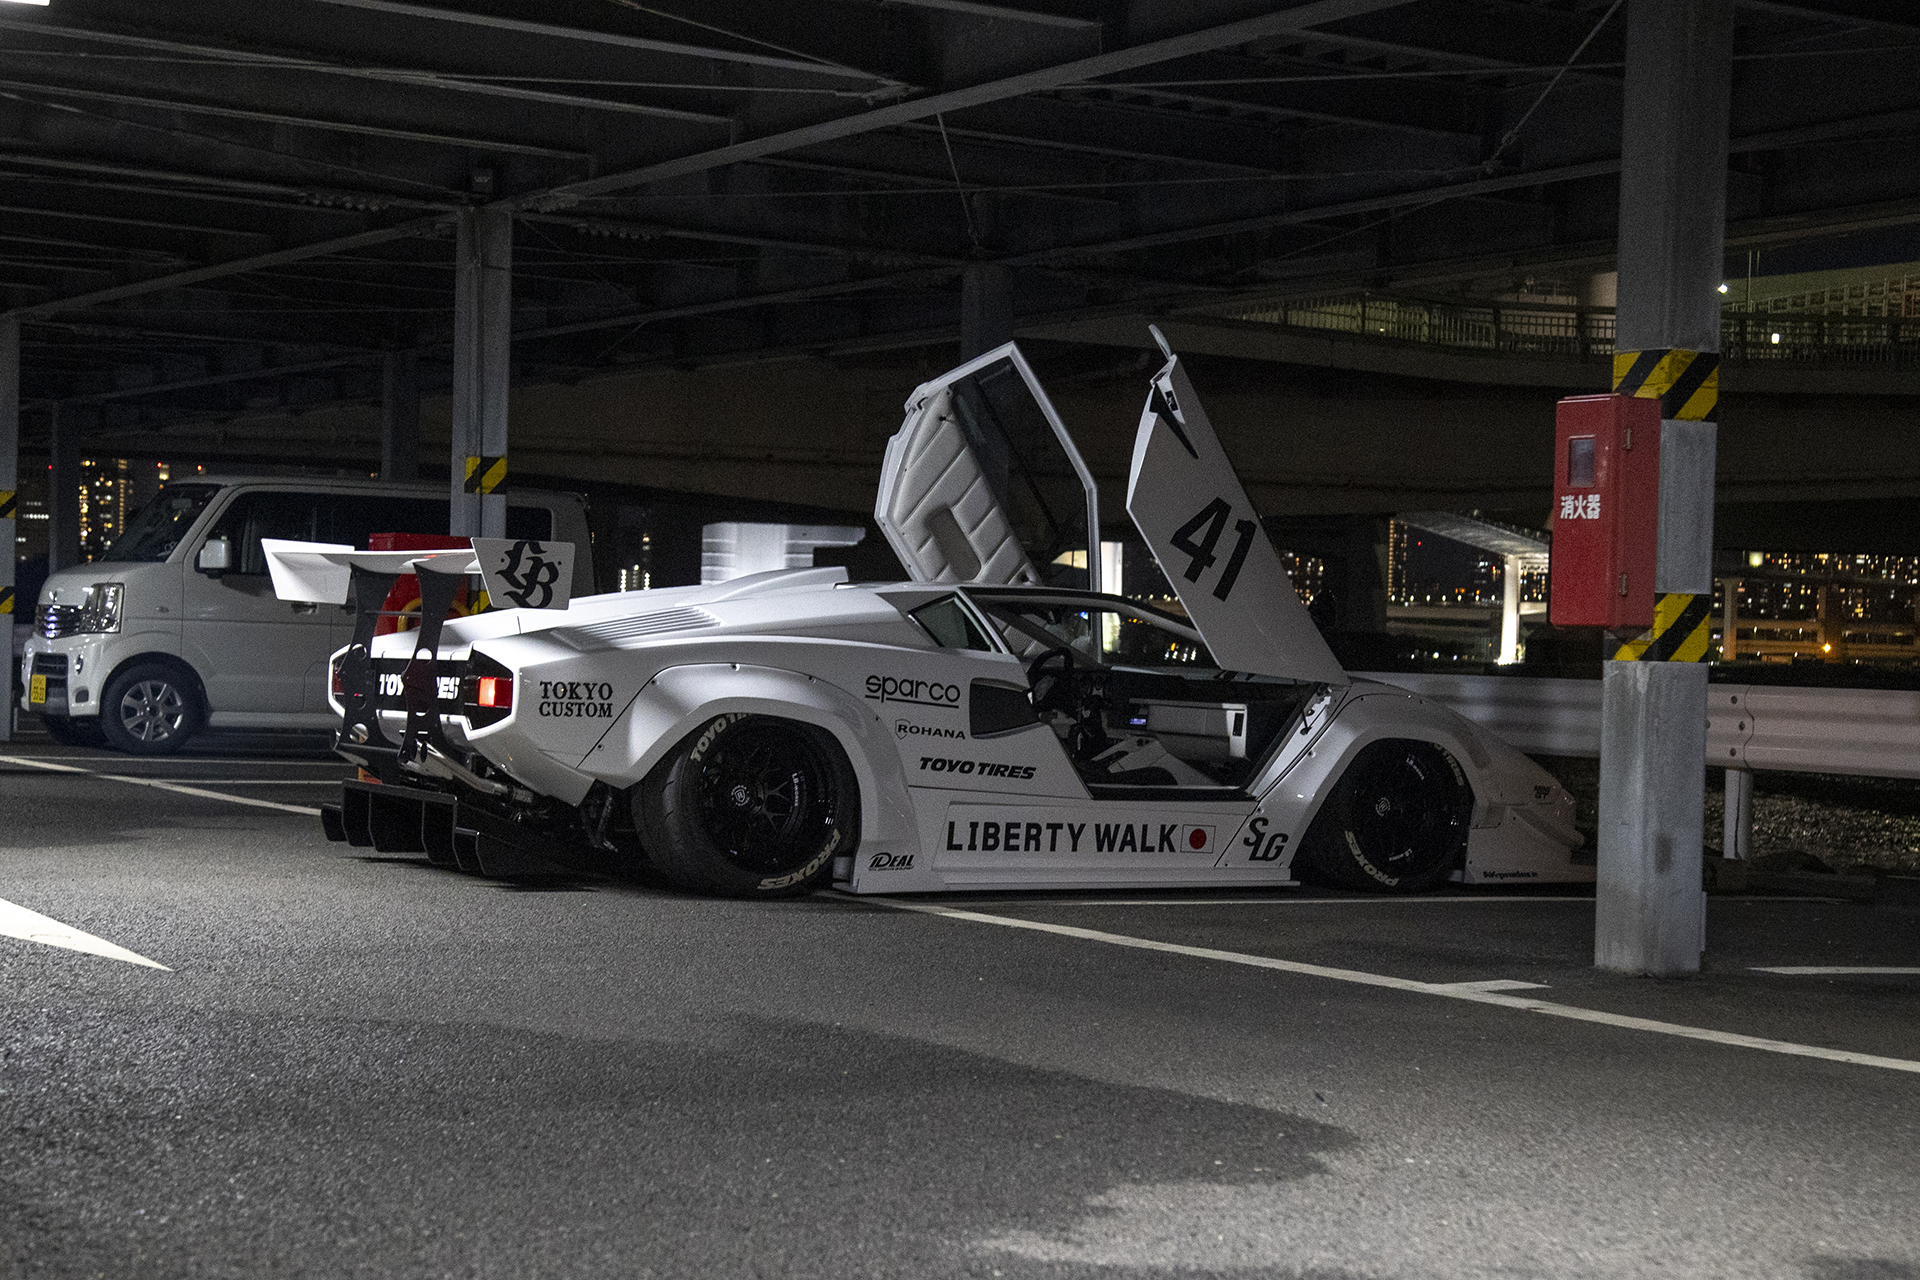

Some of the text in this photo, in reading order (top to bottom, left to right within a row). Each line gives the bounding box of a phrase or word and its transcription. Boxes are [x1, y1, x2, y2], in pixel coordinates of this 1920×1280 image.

[1560, 494, 1601, 520] 消火器
[1170, 497, 1257, 602] 41
[540, 680, 613, 700] TOKYO
[865, 675, 961, 703] sparco
[539, 701, 613, 718] CUSTOM
[690, 716, 727, 762] TOYO
[898, 724, 966, 740] ROHANA
[919, 757, 1036, 779] TOYO TIRES
[946, 821, 1178, 853] LIBERTY WALK
[756, 828, 841, 890] PROXES
[1344, 830, 1400, 887] PROXES
